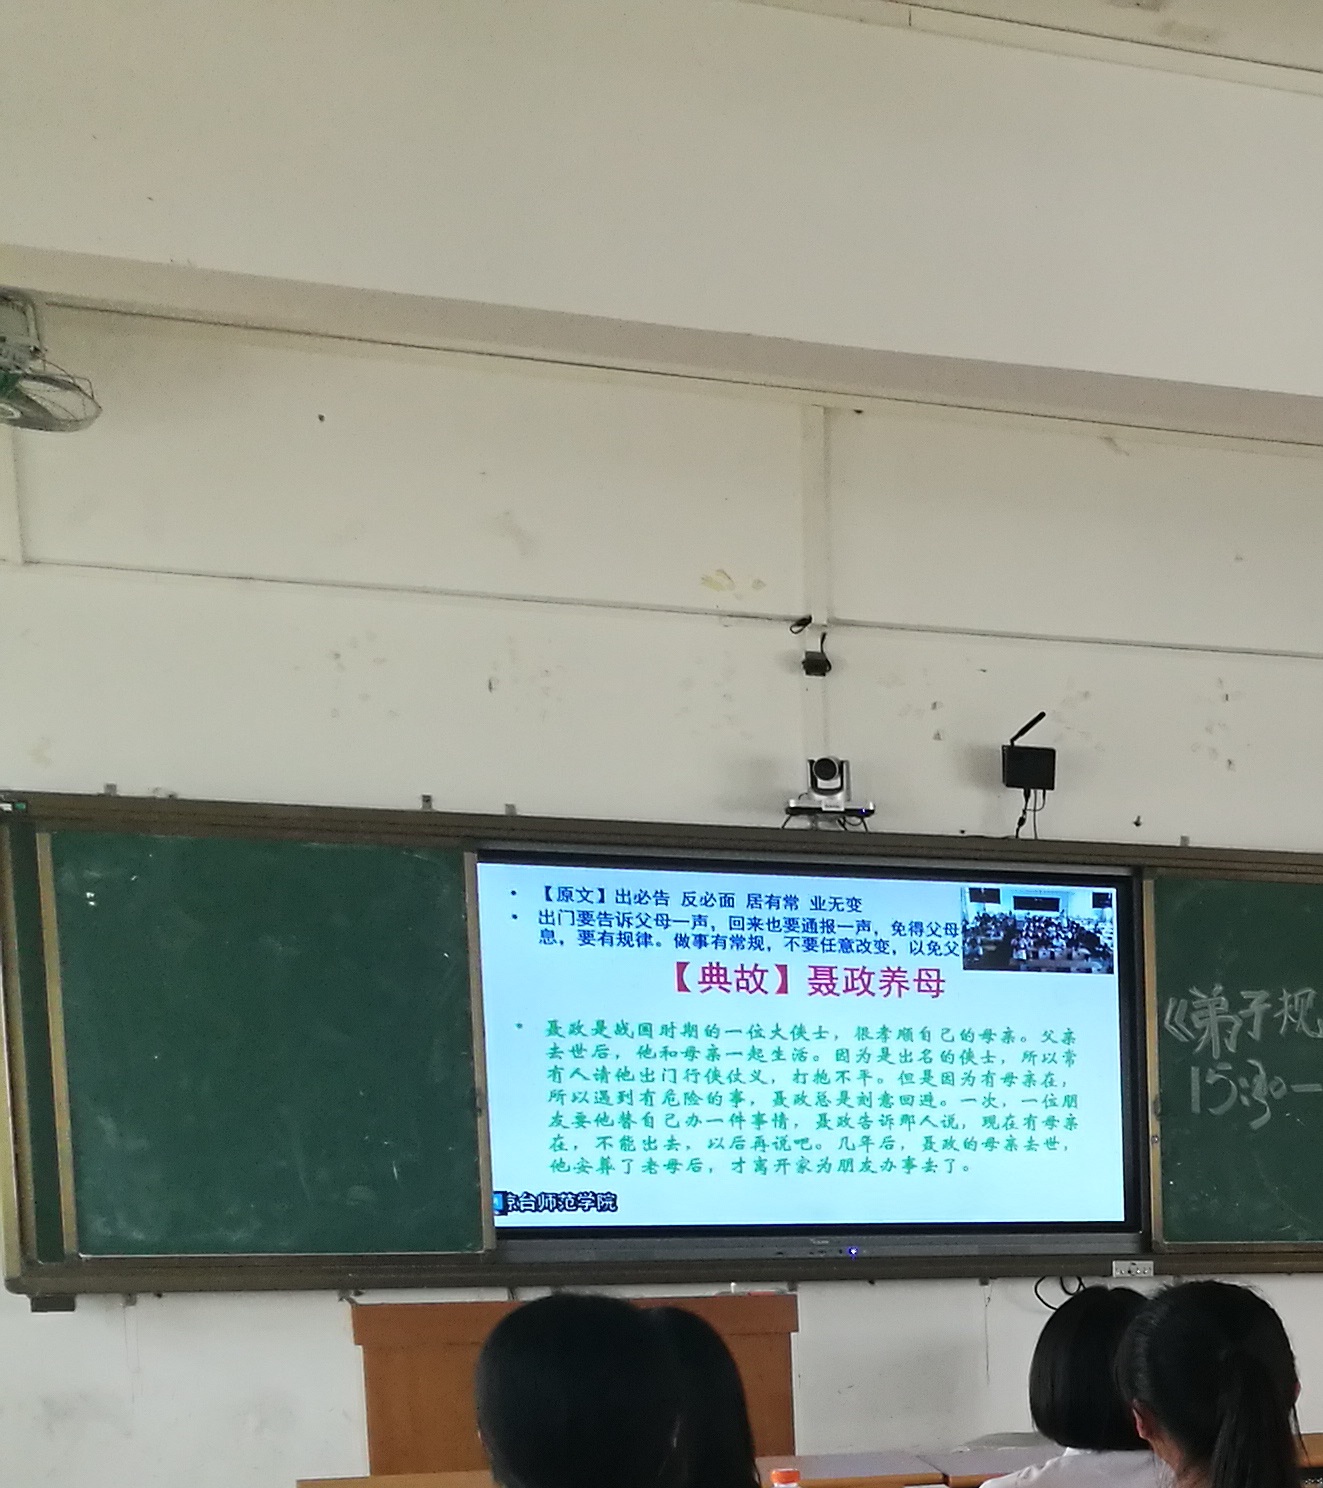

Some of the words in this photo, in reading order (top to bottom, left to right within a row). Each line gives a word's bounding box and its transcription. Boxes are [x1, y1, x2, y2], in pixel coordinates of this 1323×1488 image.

[681, 891, 735, 908] 反必面
[746, 893, 800, 911] 居有常
[810, 896, 862, 913] 业无变
